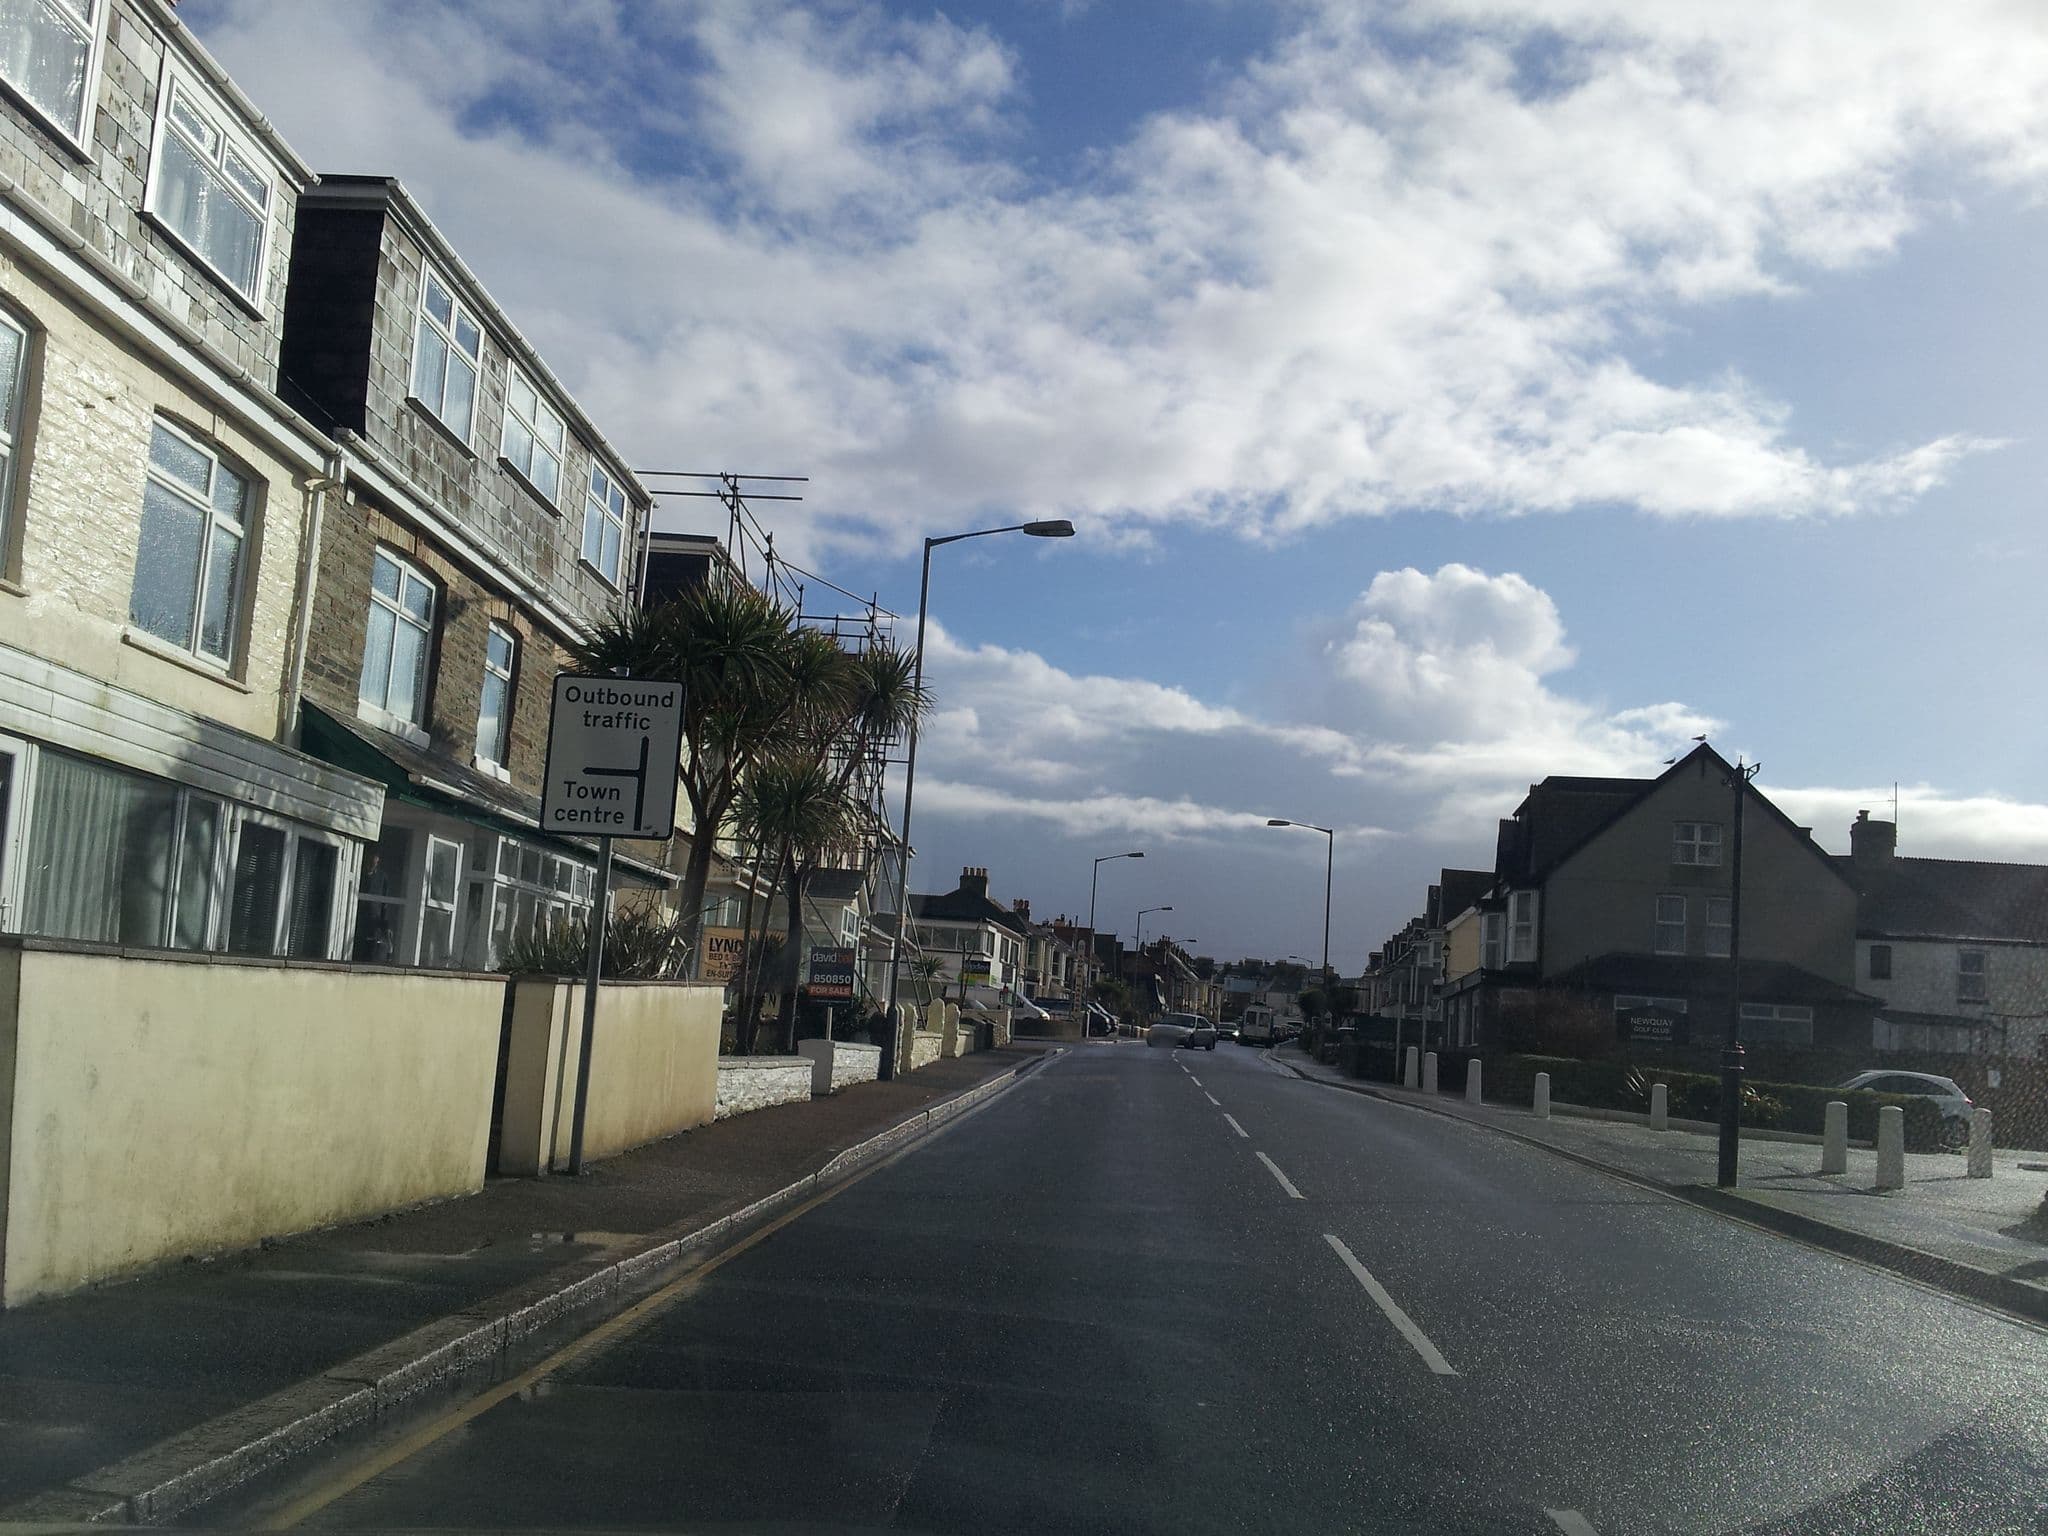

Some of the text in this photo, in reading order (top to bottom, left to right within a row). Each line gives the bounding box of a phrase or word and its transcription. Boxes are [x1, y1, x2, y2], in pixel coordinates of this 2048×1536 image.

[565, 686, 674, 708] Outbound
[583, 710, 651, 731] traffic
[563, 781, 620, 801] Town
[554, 806, 625, 824] centre
[812, 951, 837, 963] david
[814, 974, 851, 984] 850850
[810, 986, 850, 995] FOR SALE
[1630, 1017, 1673, 1027] NEWQUAY
